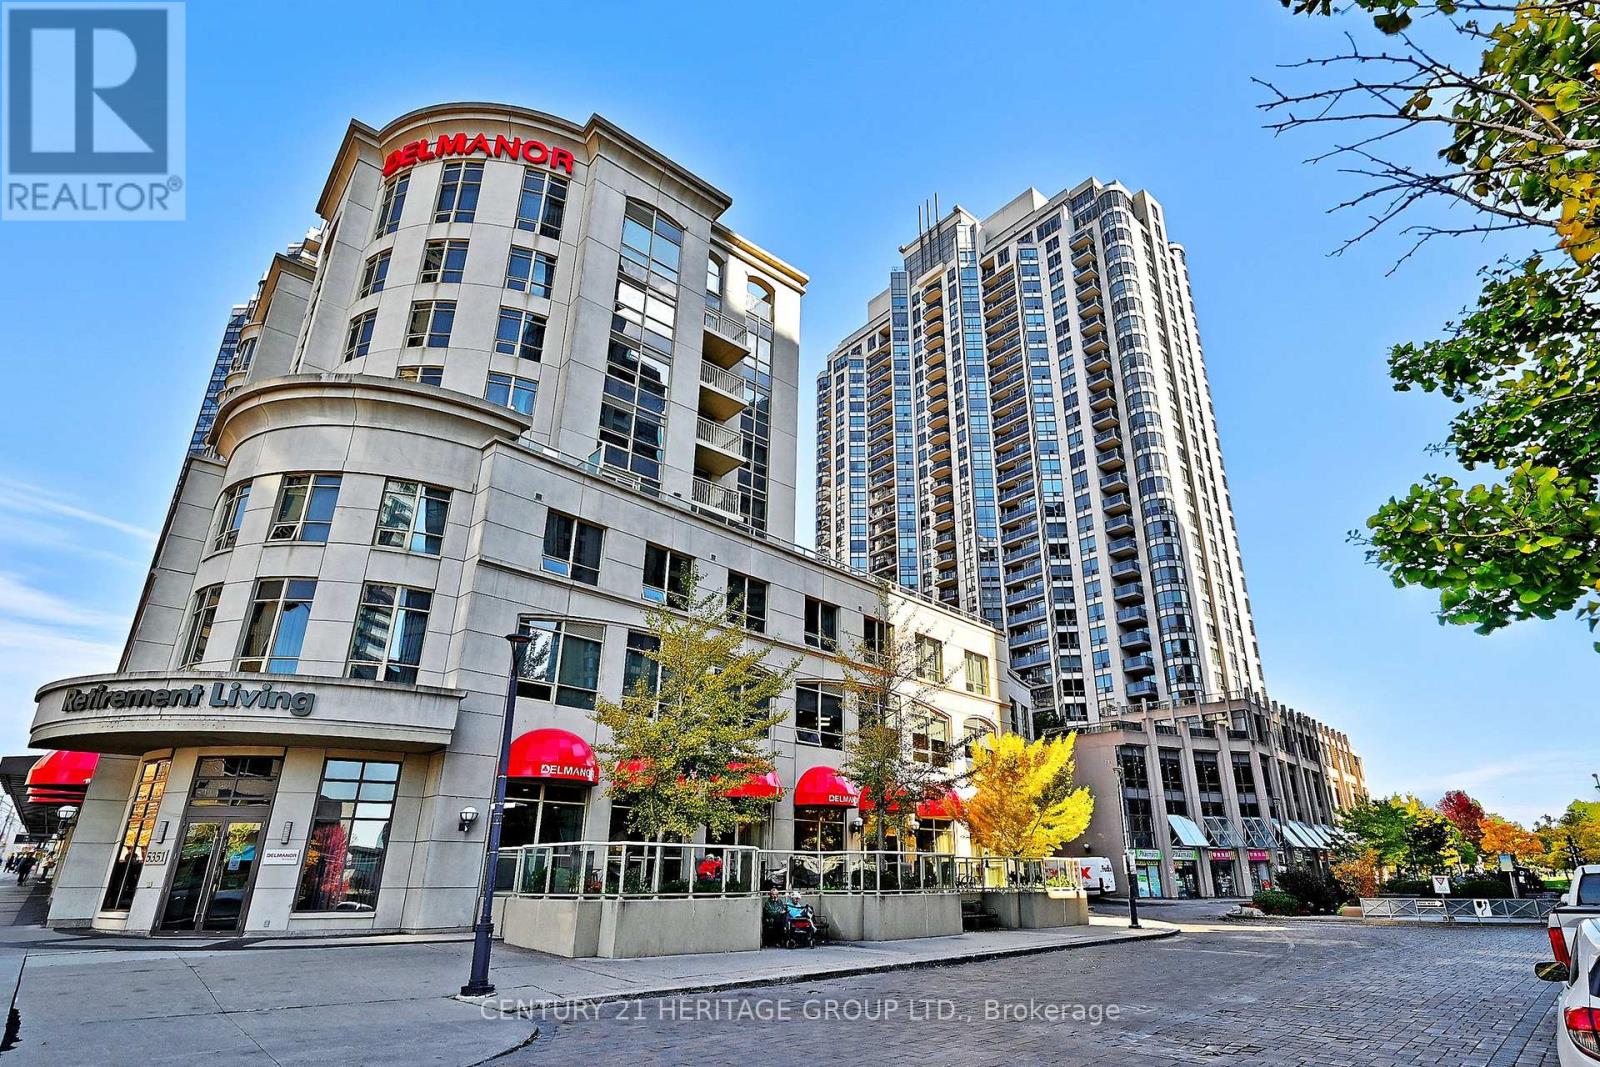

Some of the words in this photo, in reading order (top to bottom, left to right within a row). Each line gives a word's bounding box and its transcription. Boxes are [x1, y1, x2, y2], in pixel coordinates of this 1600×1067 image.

[382, 132, 576, 178] DELMANOR
[61, 683, 204, 713] Retirement
[208, 682, 317, 717] Living
[145, 850, 167, 862] 5351
